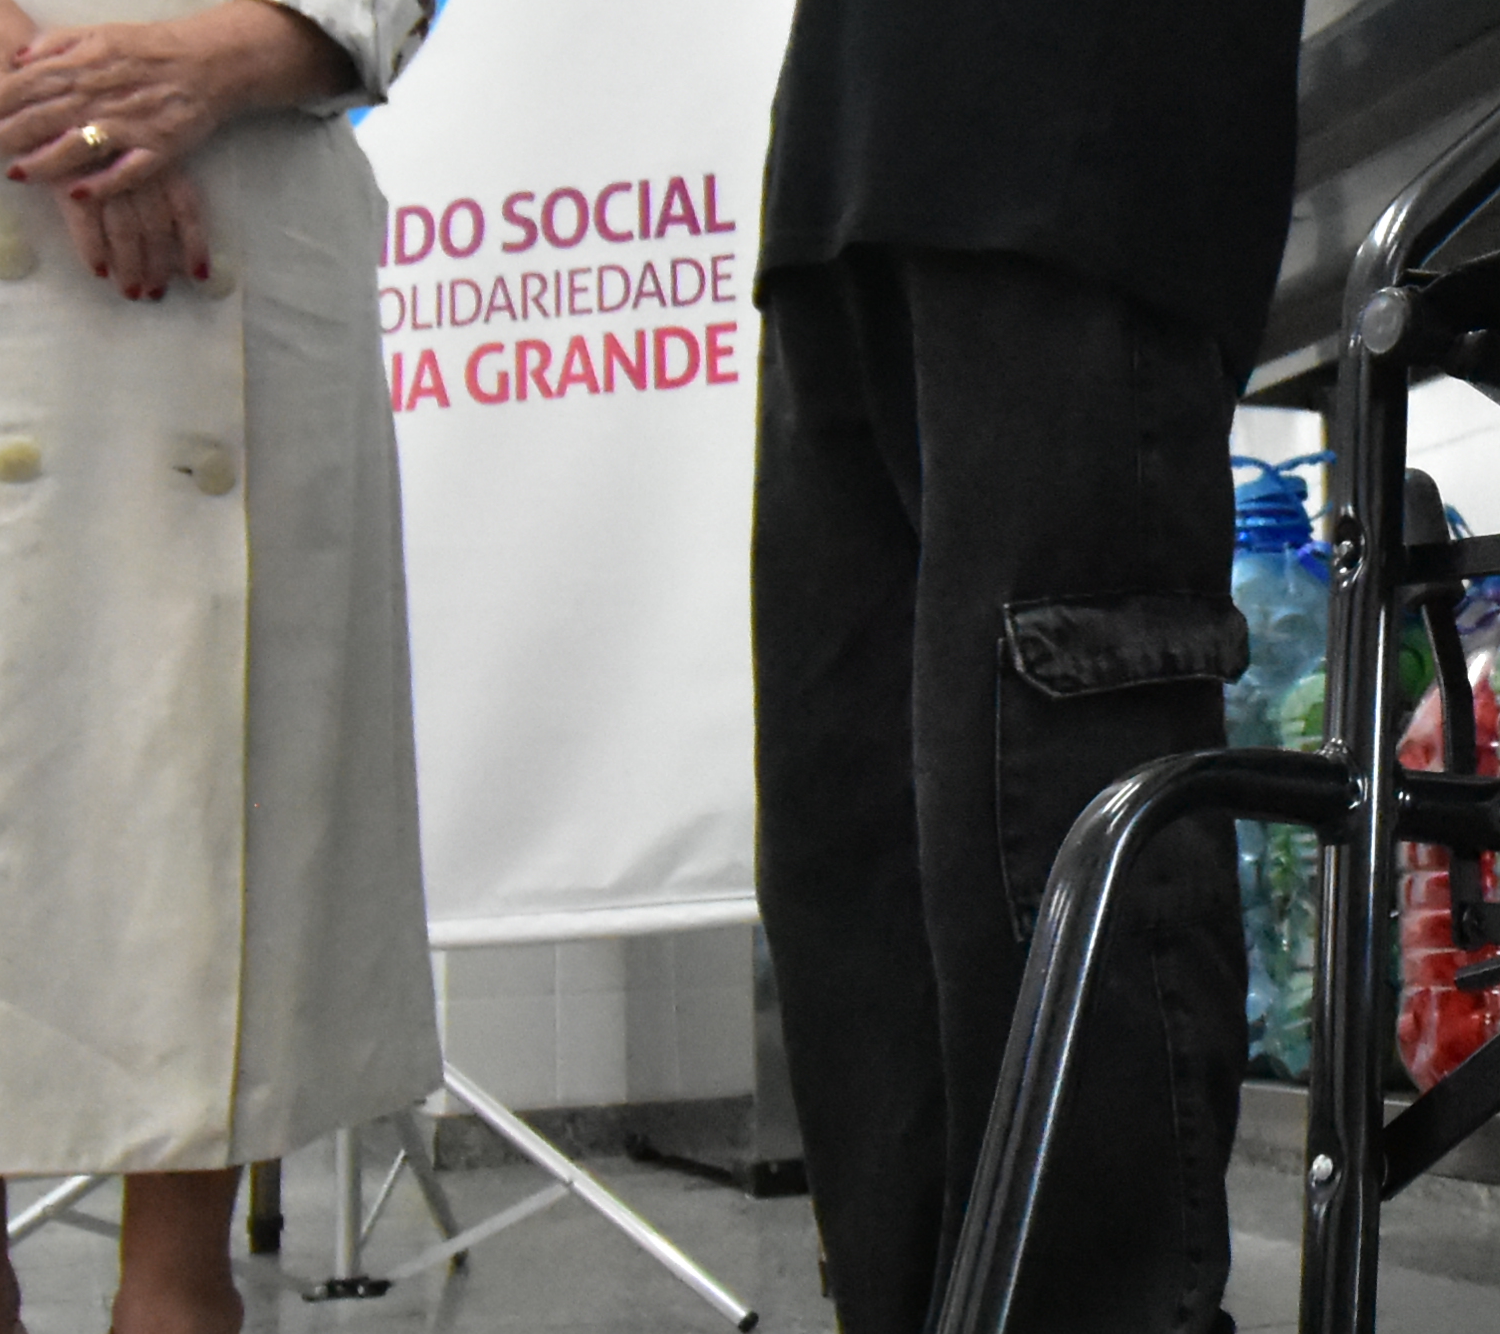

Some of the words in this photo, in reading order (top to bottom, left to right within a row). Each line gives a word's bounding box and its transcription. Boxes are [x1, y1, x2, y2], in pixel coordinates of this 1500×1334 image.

[380, 197, 485, 268] DO
[501, 173, 736, 253] SOCIAL
[379, 253, 737, 335] OLIDARIEDADE
[464, 321, 739, 406] GRANDE
